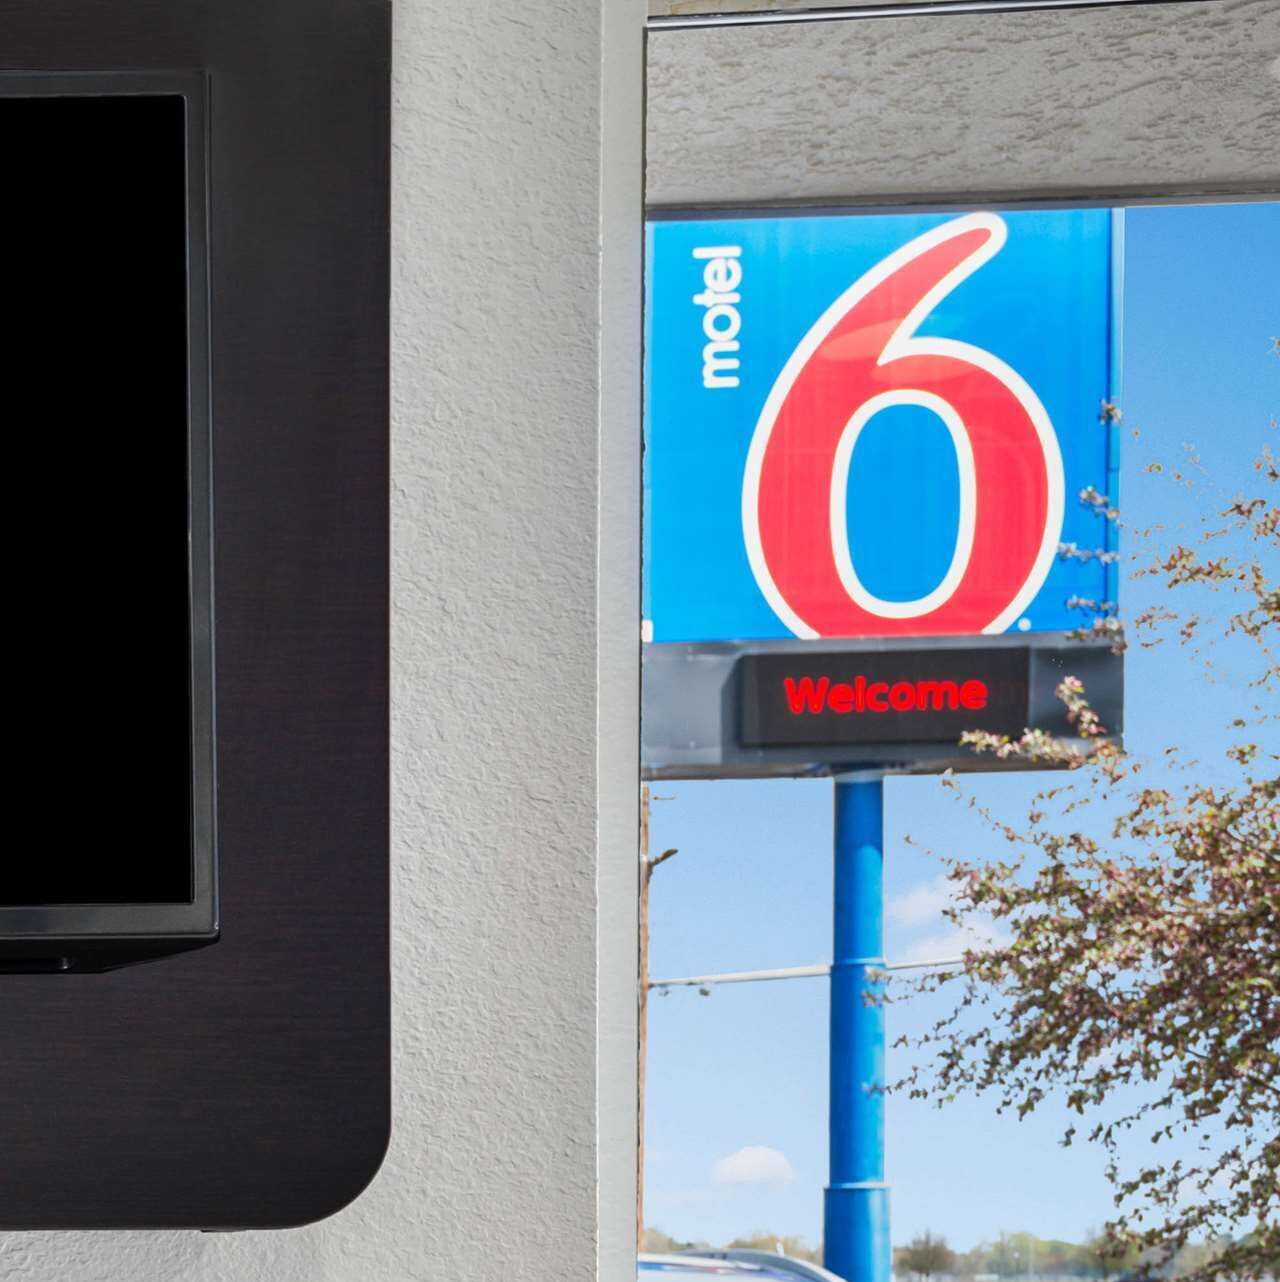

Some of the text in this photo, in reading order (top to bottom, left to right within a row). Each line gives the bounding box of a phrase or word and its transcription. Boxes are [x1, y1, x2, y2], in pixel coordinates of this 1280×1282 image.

[693, 212, 1065, 640] motel 6
[784, 675, 988, 713] Welcome
